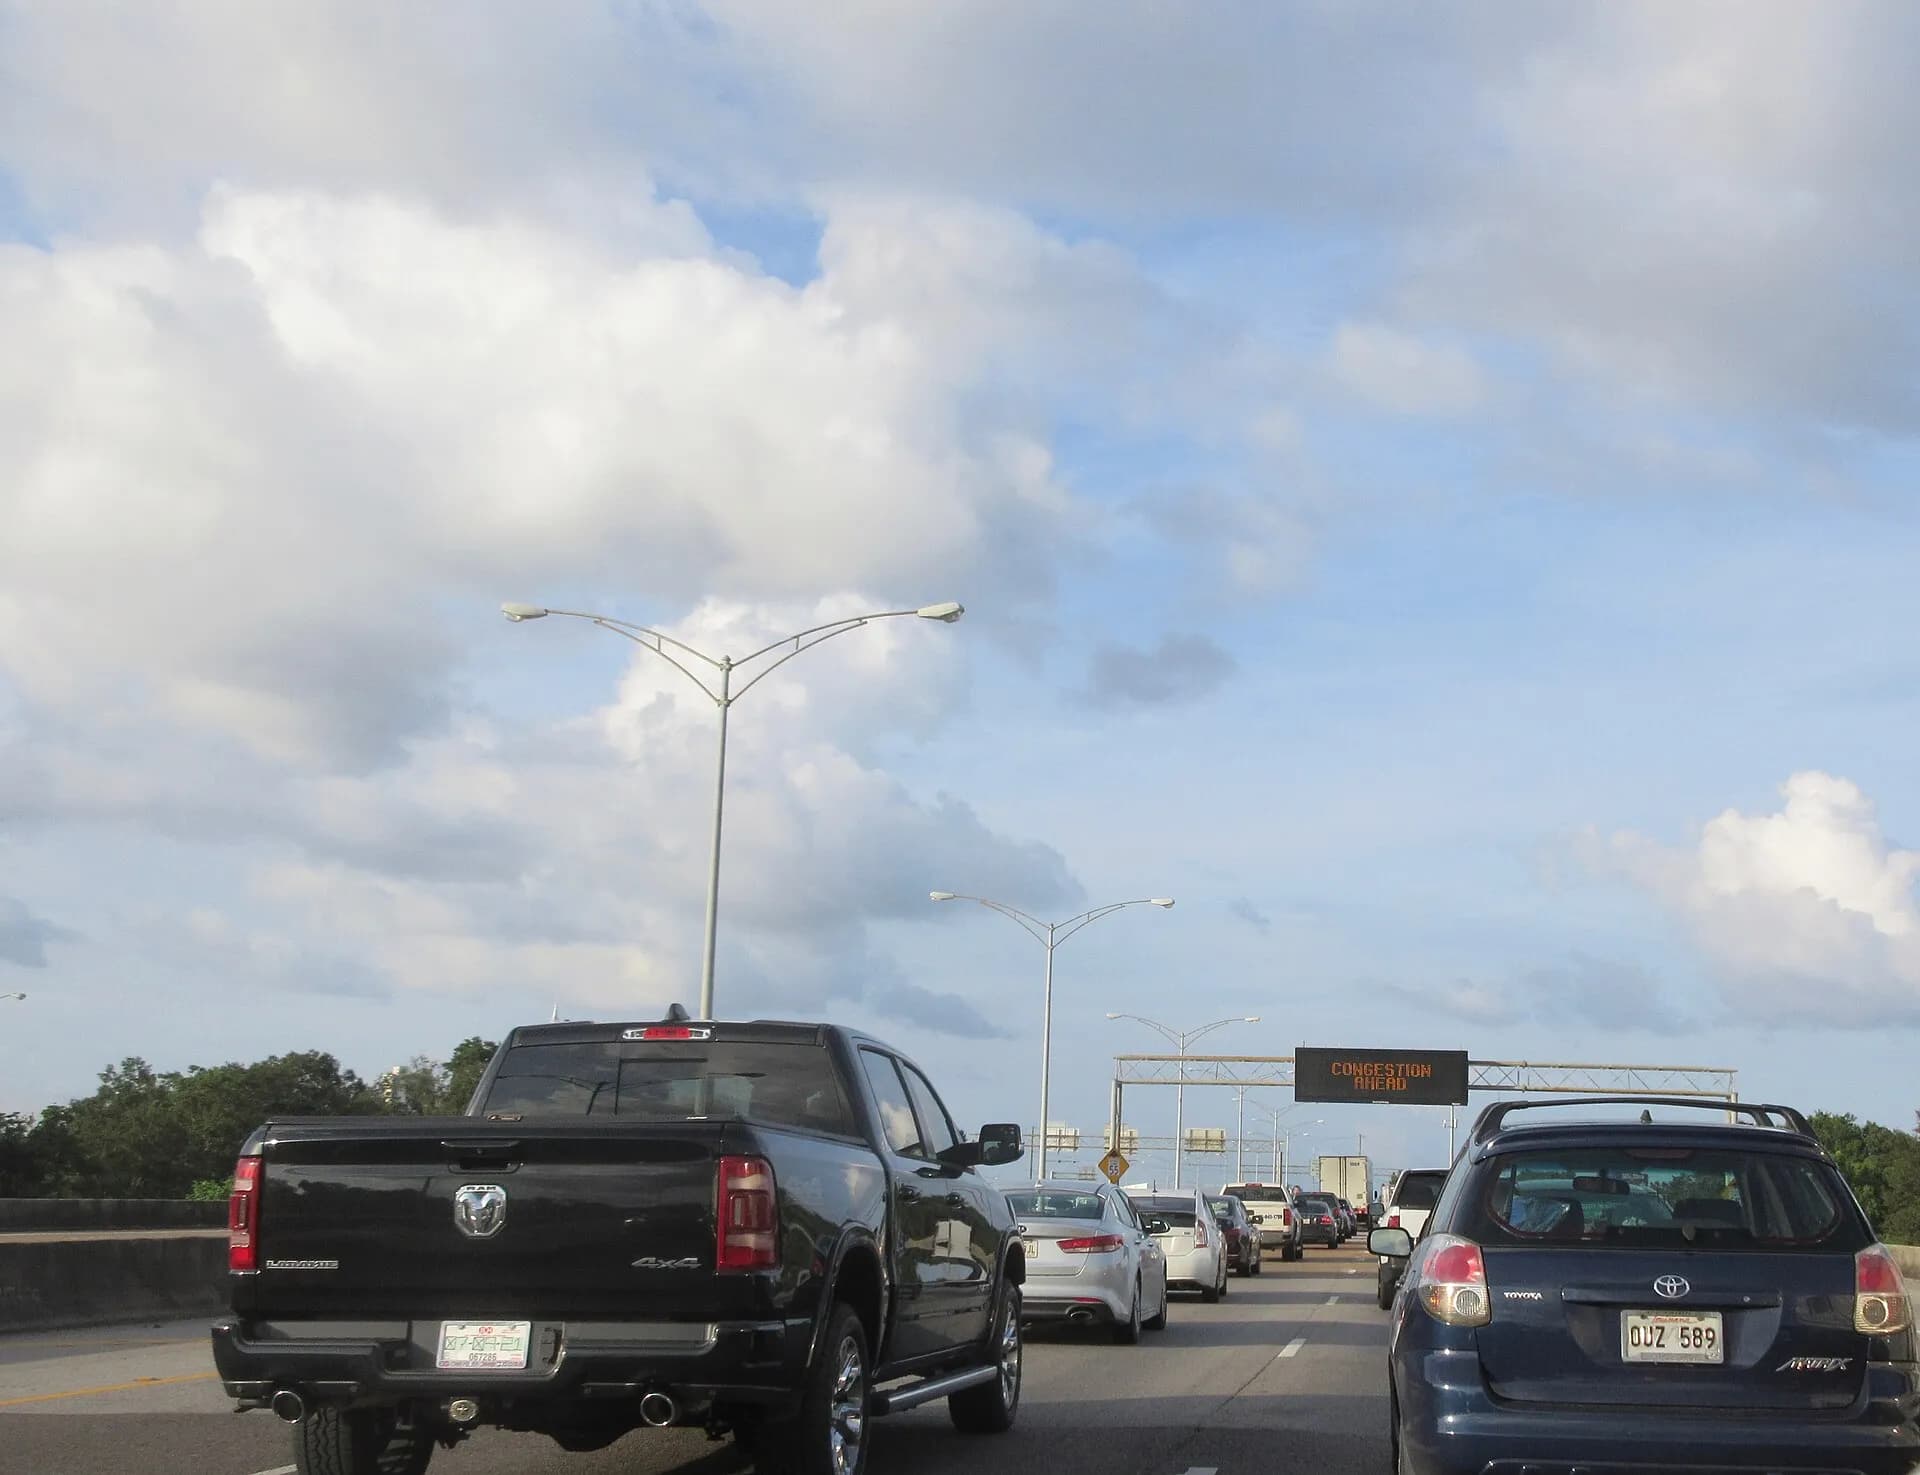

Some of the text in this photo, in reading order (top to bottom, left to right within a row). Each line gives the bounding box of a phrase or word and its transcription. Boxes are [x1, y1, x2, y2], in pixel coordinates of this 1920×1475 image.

[1331, 1062, 1431, 1078] CONGESTION
[1354, 1076, 1408, 1091] AHEAD
[1109, 1165, 1119, 1176] 55
[1503, 1292, 1544, 1300] TOYOTA
[1680, 1327, 1716, 1349] 589
